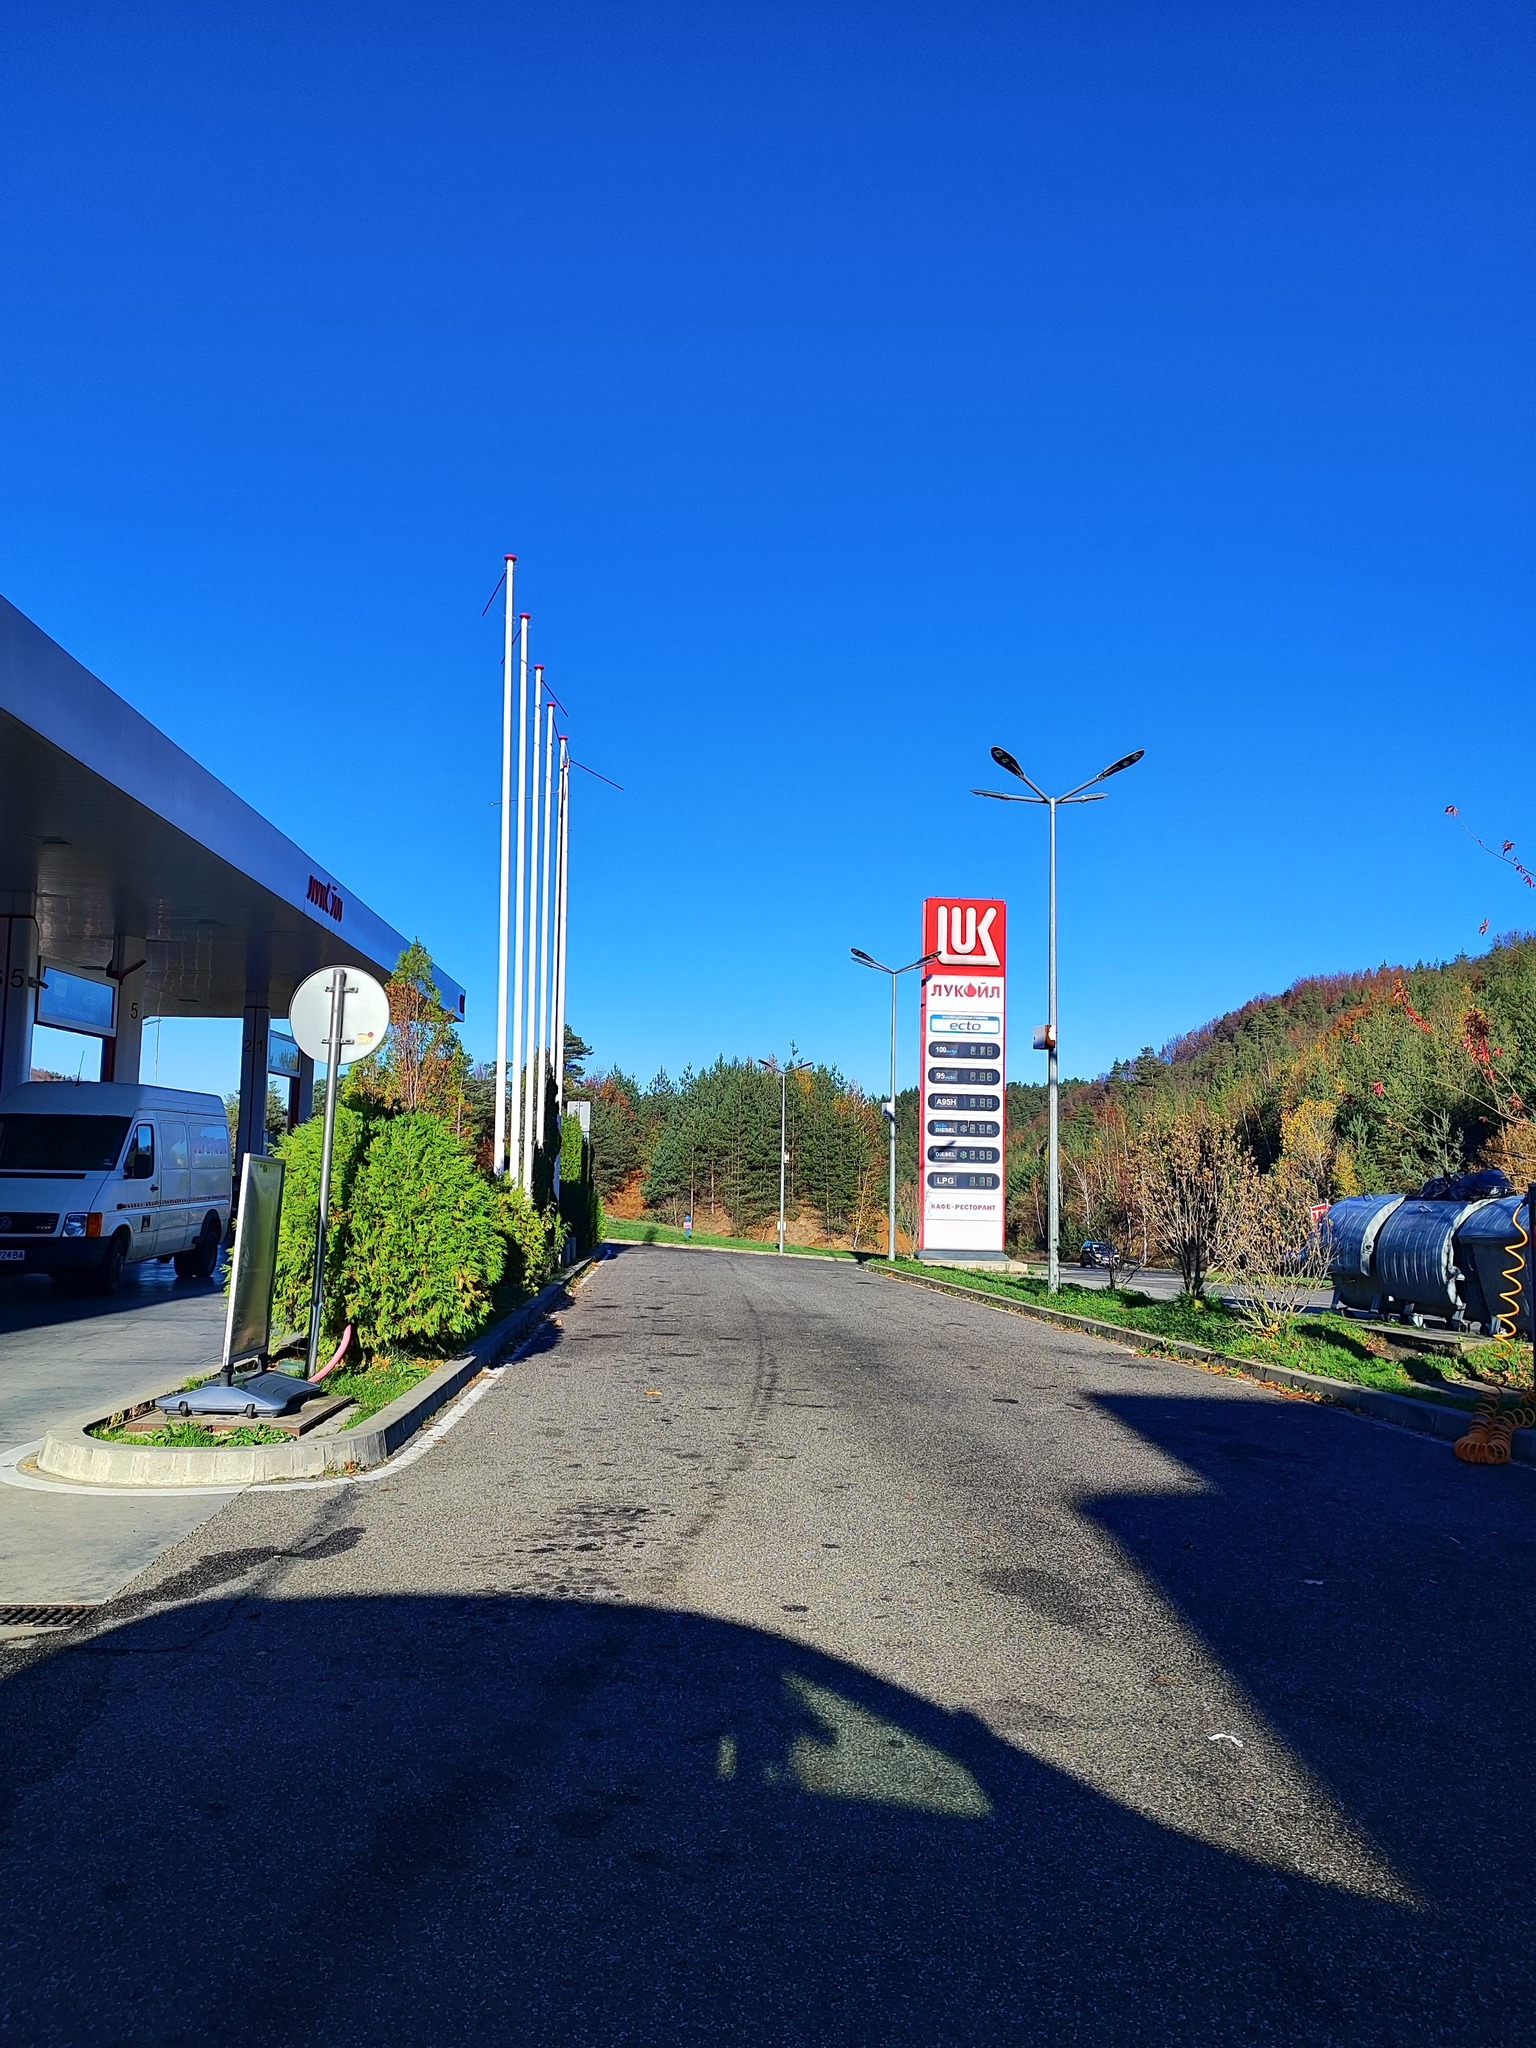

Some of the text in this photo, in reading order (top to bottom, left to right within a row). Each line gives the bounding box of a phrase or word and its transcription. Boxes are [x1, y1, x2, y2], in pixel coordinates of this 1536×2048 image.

[10, 968, 25, 989] 5
[931, 982, 1000, 999] ЛУКОЙЛ
[130, 1002, 139, 1020] 5
[950, 1021, 981, 1030] ecto
[244, 1039, 252, 1053] 2
[256, 1039, 263, 1053] 1
[936, 1176, 954, 1185] LPG
